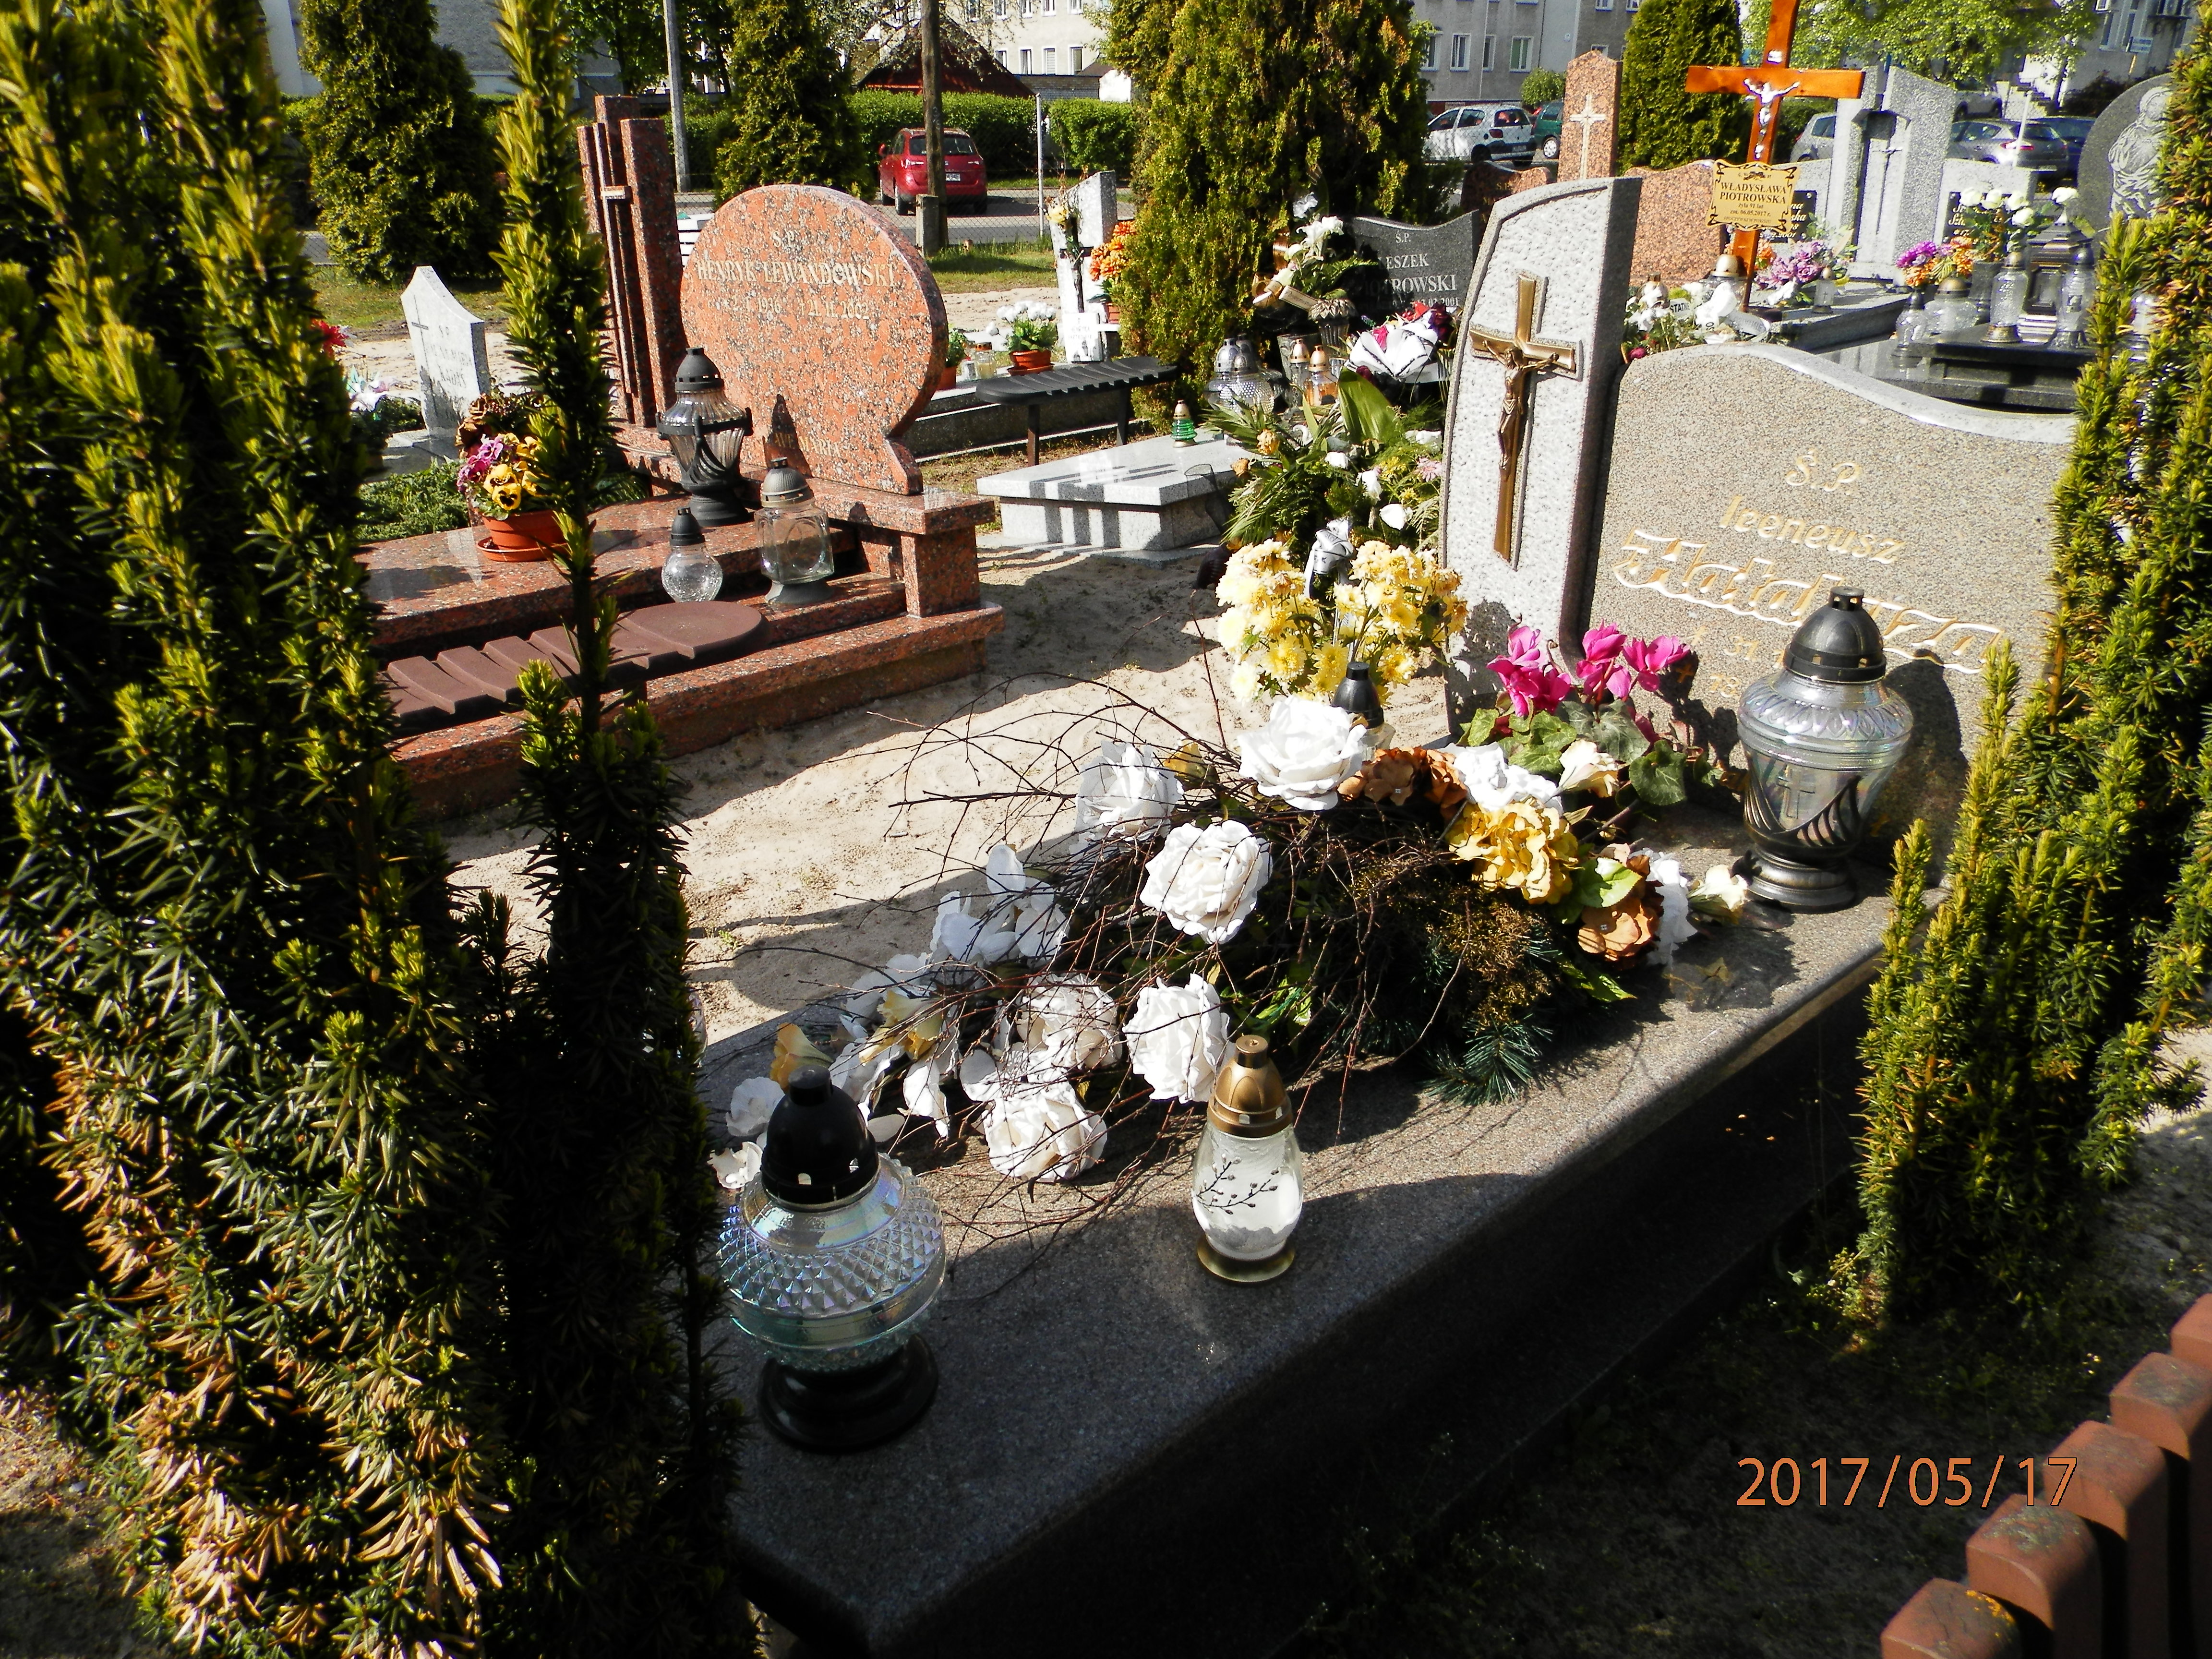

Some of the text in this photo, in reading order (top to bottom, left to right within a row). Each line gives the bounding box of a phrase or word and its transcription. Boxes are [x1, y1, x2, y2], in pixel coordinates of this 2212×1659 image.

[1720, 182, 1787, 194] WŁADYSŁAWA
[1719, 191, 1786, 204] PIOTROWSKA
[696, 259, 895, 287] HENRYK LEWANDOWSKI
[798, 435, 842, 458] MARIA
